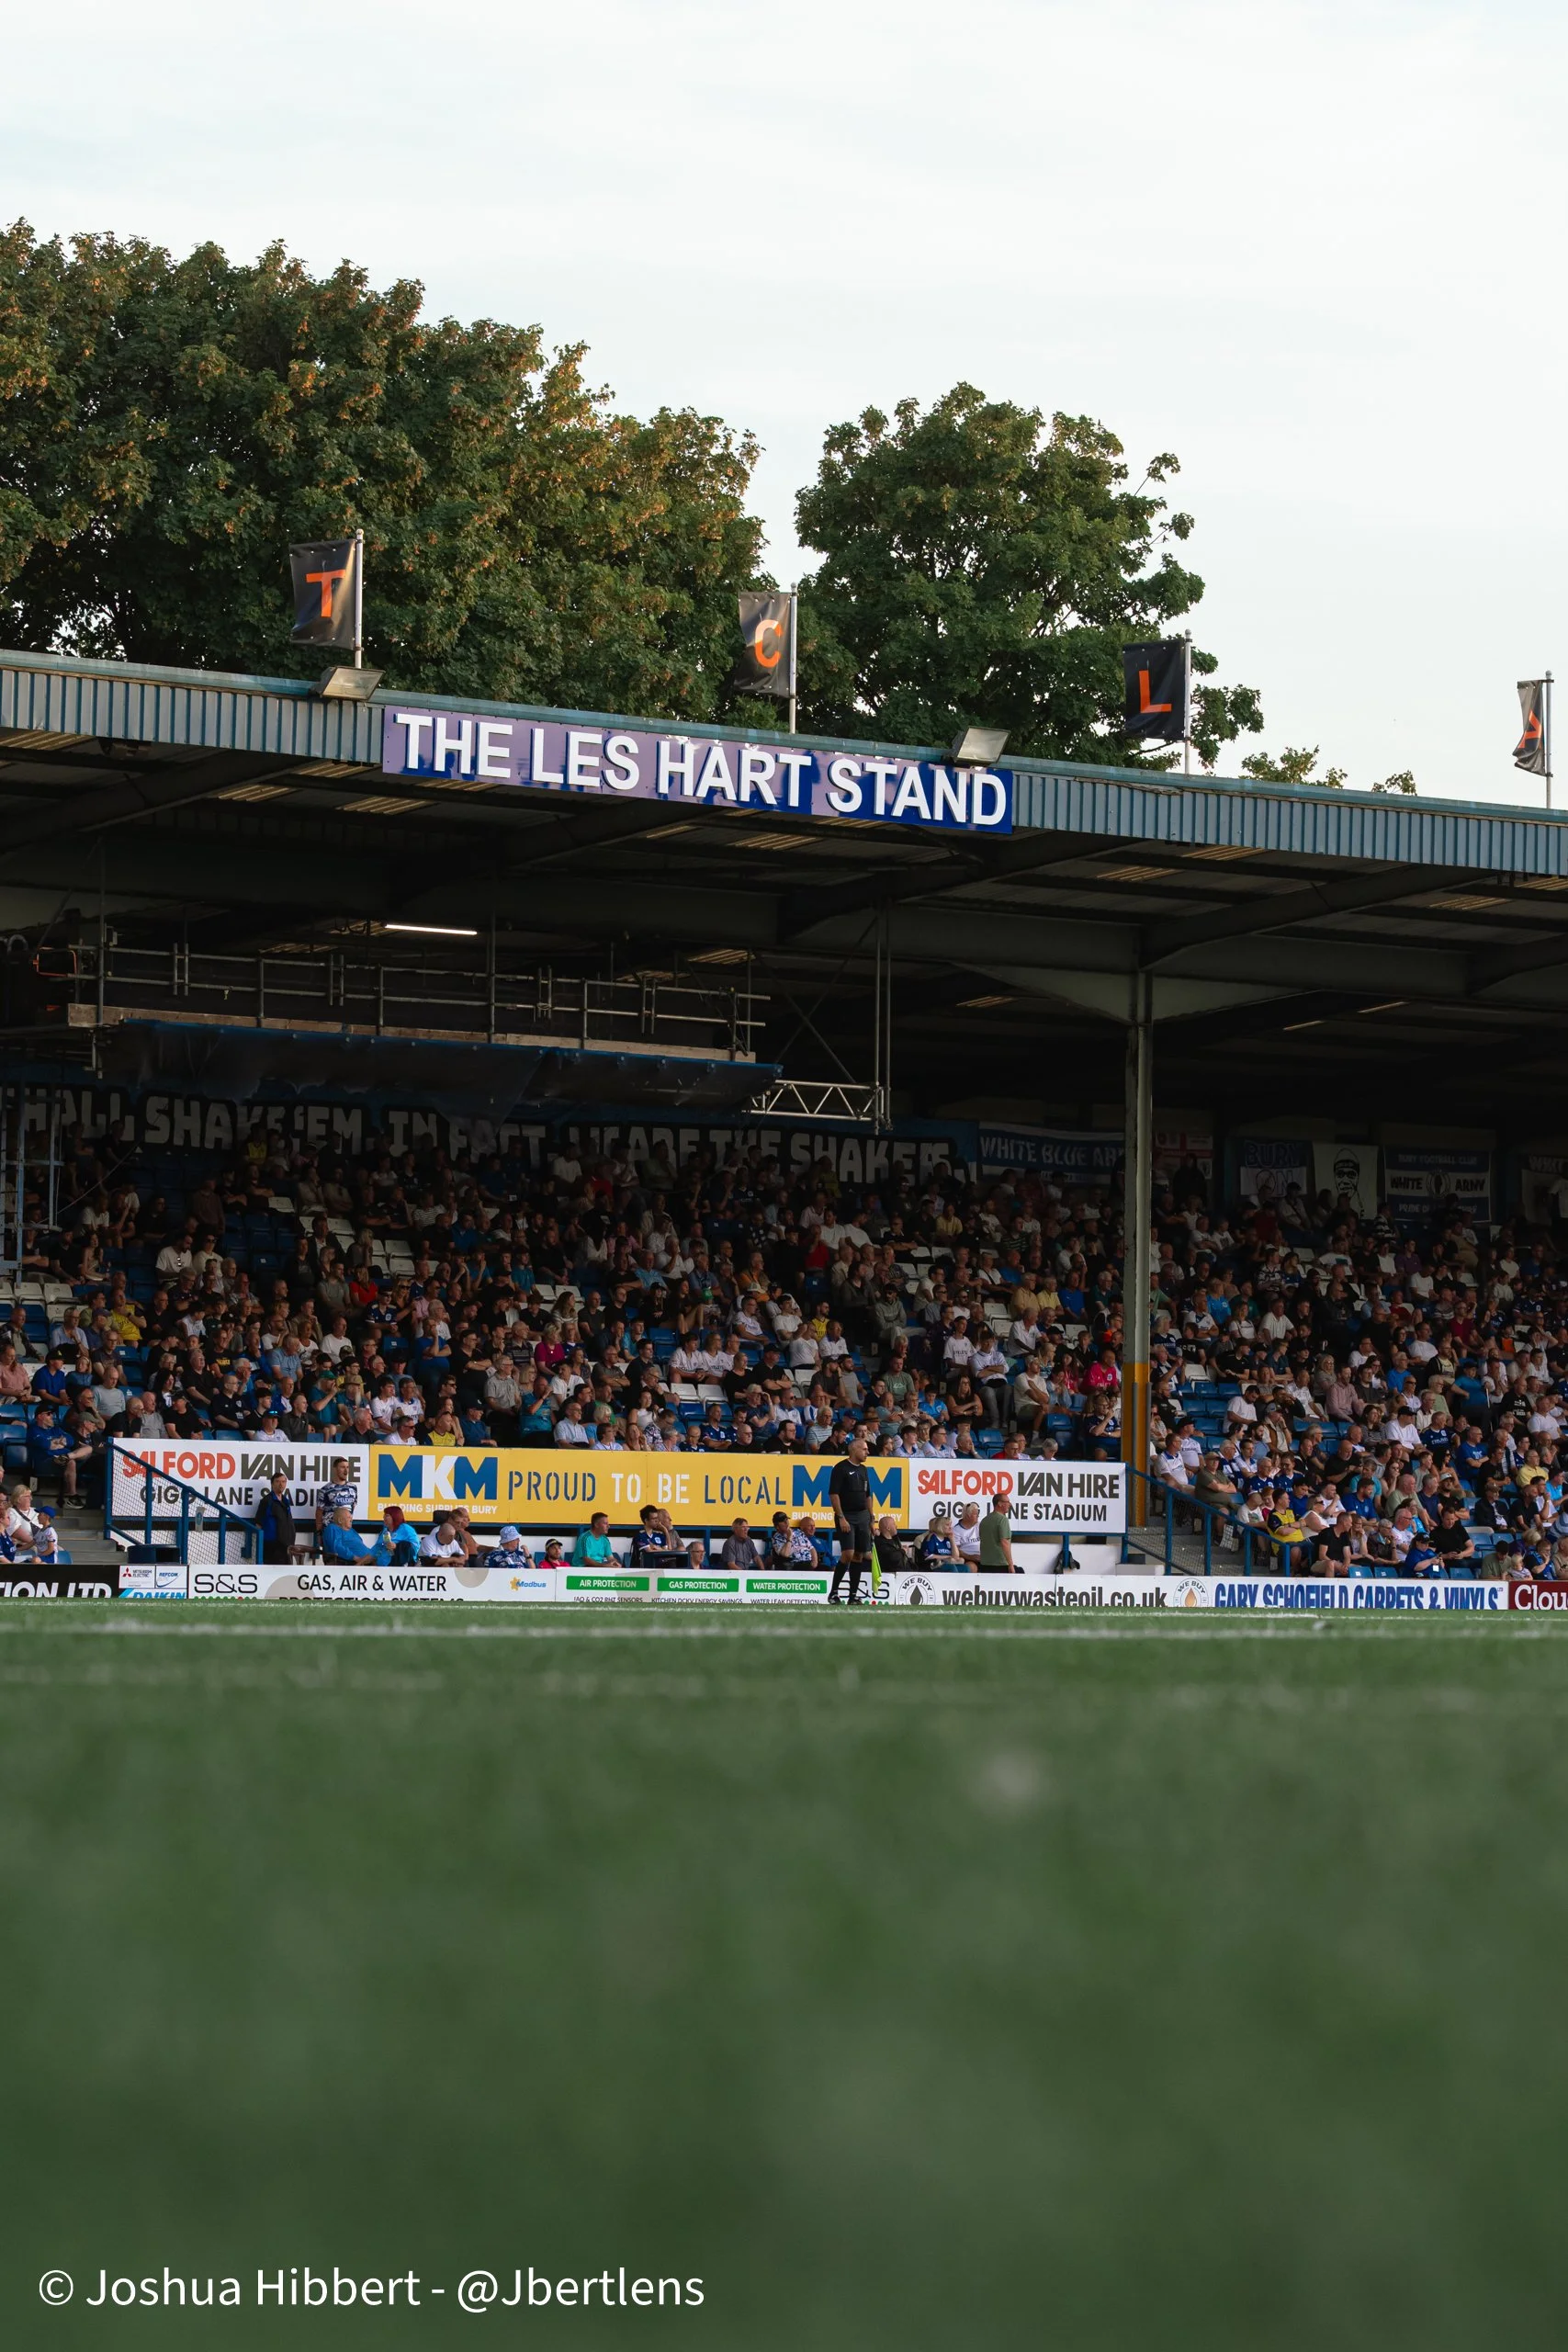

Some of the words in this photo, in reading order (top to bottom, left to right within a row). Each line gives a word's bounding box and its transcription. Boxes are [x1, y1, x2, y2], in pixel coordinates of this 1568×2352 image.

[306, 569, 345, 616] T
[754, 619, 782, 668] C
[1139, 670, 1171, 713] L
[394, 713, 513, 778] THE
[531, 728, 639, 791] LES
[657, 740, 811, 807] HART
[827, 758, 1006, 825] STAND
[388, 1110, 438, 1157] IN
[980, 1136, 1037, 1162] WHITE
[1042, 1144, 1088, 1166] BLUE
[1391, 1176, 1423, 1190] WHITE
[1455, 1178, 1485, 1192] ARMY
[122, 1451, 236, 1479] SALFORD
[241, 1453, 295, 1482] VAN
[378, 1453, 498, 1500] MKM
[508, 1471, 596, 1502] PROUD
[611, 1473, 641, 1503] TO
[658, 1473, 690, 1504] BE
[704, 1475, 786, 1505] LOCAL
[792, 1464, 902, 1509] MM
[918, 1470, 1013, 1496] SALFORD
[1017, 1472, 1063, 1498] VAN
[1067, 1473, 1120, 1499] HIRE
[471, 1505, 497, 1515] BURY
[1034, 1503, 1108, 1522] STADIUM
[194, 1574, 257, 1594] S&S
[297, 1574, 334, 1592] GAS,
[340, 1575, 367, 1590] AIR
[372, 1576, 384, 1591] &
[389, 1575, 446, 1591] WATER
[580, 1579, 592, 1588] AIR
[592, 1579, 637, 1589] PROTECTION
[669, 1580, 683, 1589] GAS
[684, 1580, 728, 1589] PROTECTION
[753, 1582, 776, 1590] WATER
[777, 1582, 820, 1591] PROTECTION
[902, 1578, 916, 1589] WE
[917, 1577, 932, 1591] BUY
[1178, 1580, 1190, 1592] WE
[1191, 1580, 1206, 1594] BUY
[942, 1585, 1168, 1607] webuywasteoil.co.uk
[1215, 1583, 1258, 1608] GARY
[1263, 1583, 1348, 1609] SCHOFIELD
[1353, 1584, 1424, 1609] CARPETS
[1429, 1585, 1441, 1609] &
[1444, 1586, 1498, 1610] VINYLS
[1515, 1584, 1568, 1610] Clou
